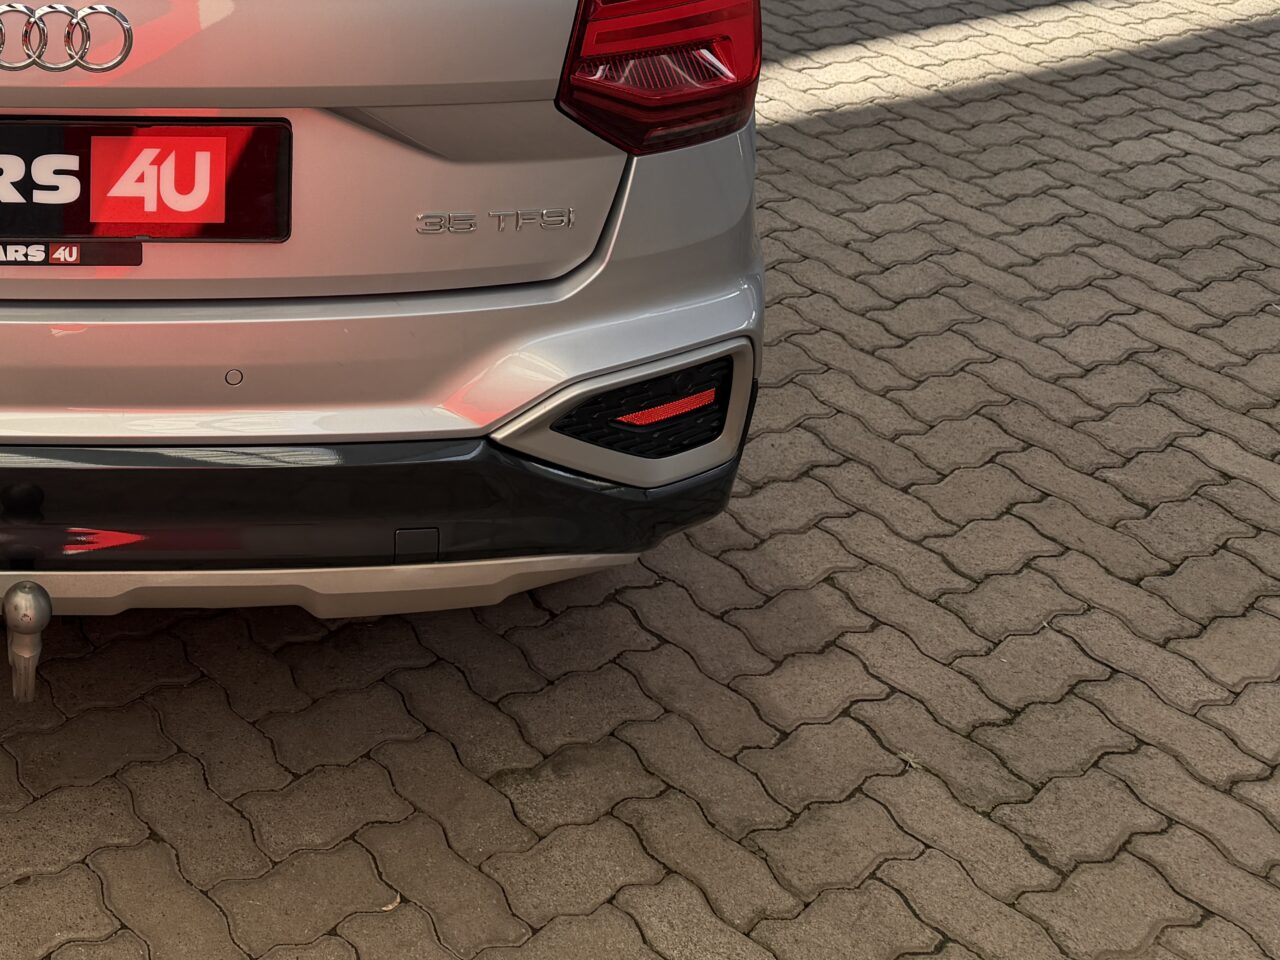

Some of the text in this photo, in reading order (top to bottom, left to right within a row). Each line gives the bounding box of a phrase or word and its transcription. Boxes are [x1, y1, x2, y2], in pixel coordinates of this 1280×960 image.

[106, 148, 211, 212] 4U
[416, 207, 575, 235] 35 TFSI
[52, 245, 78, 262] 4U
